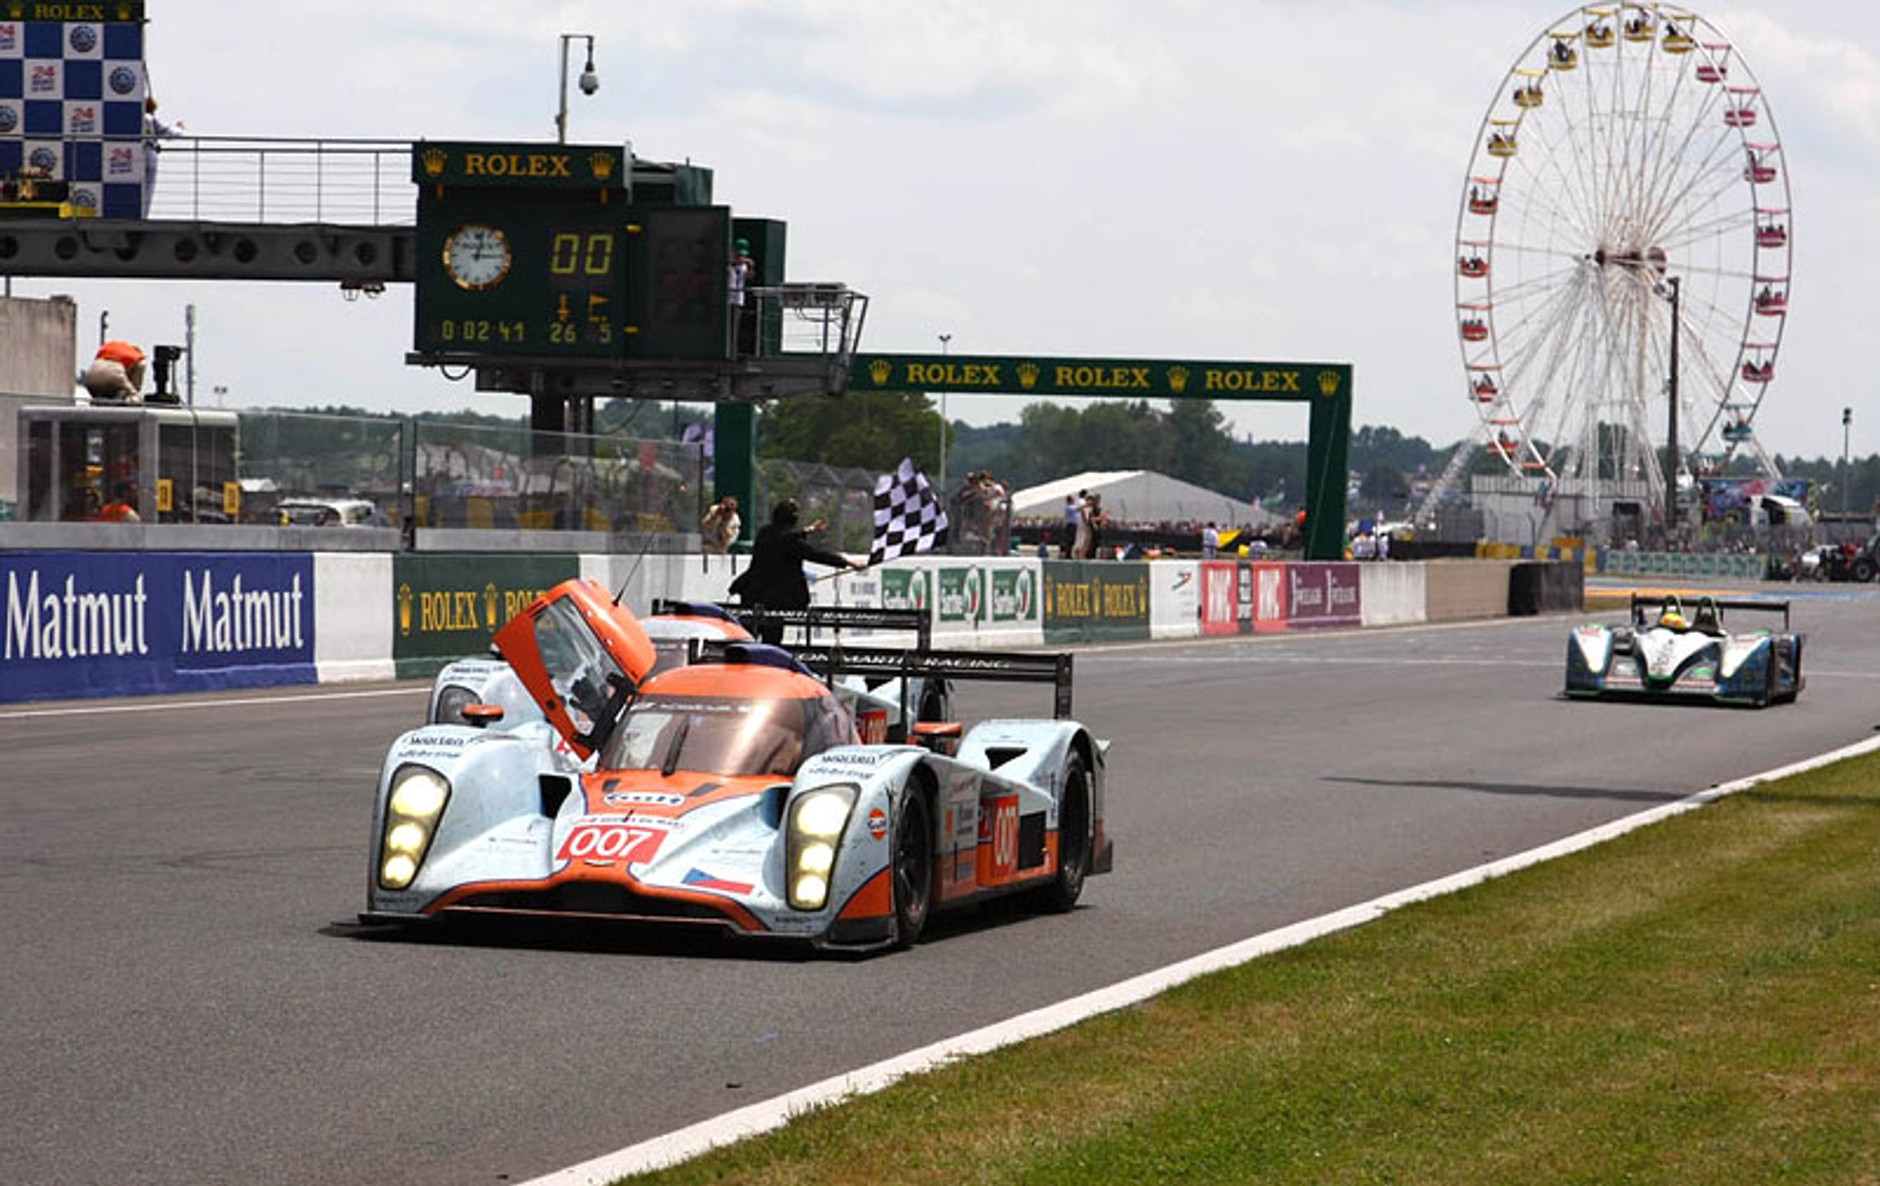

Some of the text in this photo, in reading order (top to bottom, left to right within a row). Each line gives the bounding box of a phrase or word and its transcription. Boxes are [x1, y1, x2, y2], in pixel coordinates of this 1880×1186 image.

[35, 4, 104, 19] ROLEX
[464, 153, 572, 177] ROLEX
[551, 234, 613, 274] 00
[551, 321, 576, 343] 26
[906, 363, 1300, 392] ROLEX ROLEX ROLEX
[5, 570, 148, 659] Matmut
[182, 569, 304, 652] Matmut
[420, 591, 480, 631] ROLEX
[1057, 583, 1137, 617] ROLEX ROLEX
[569, 828, 655, 858] 007
